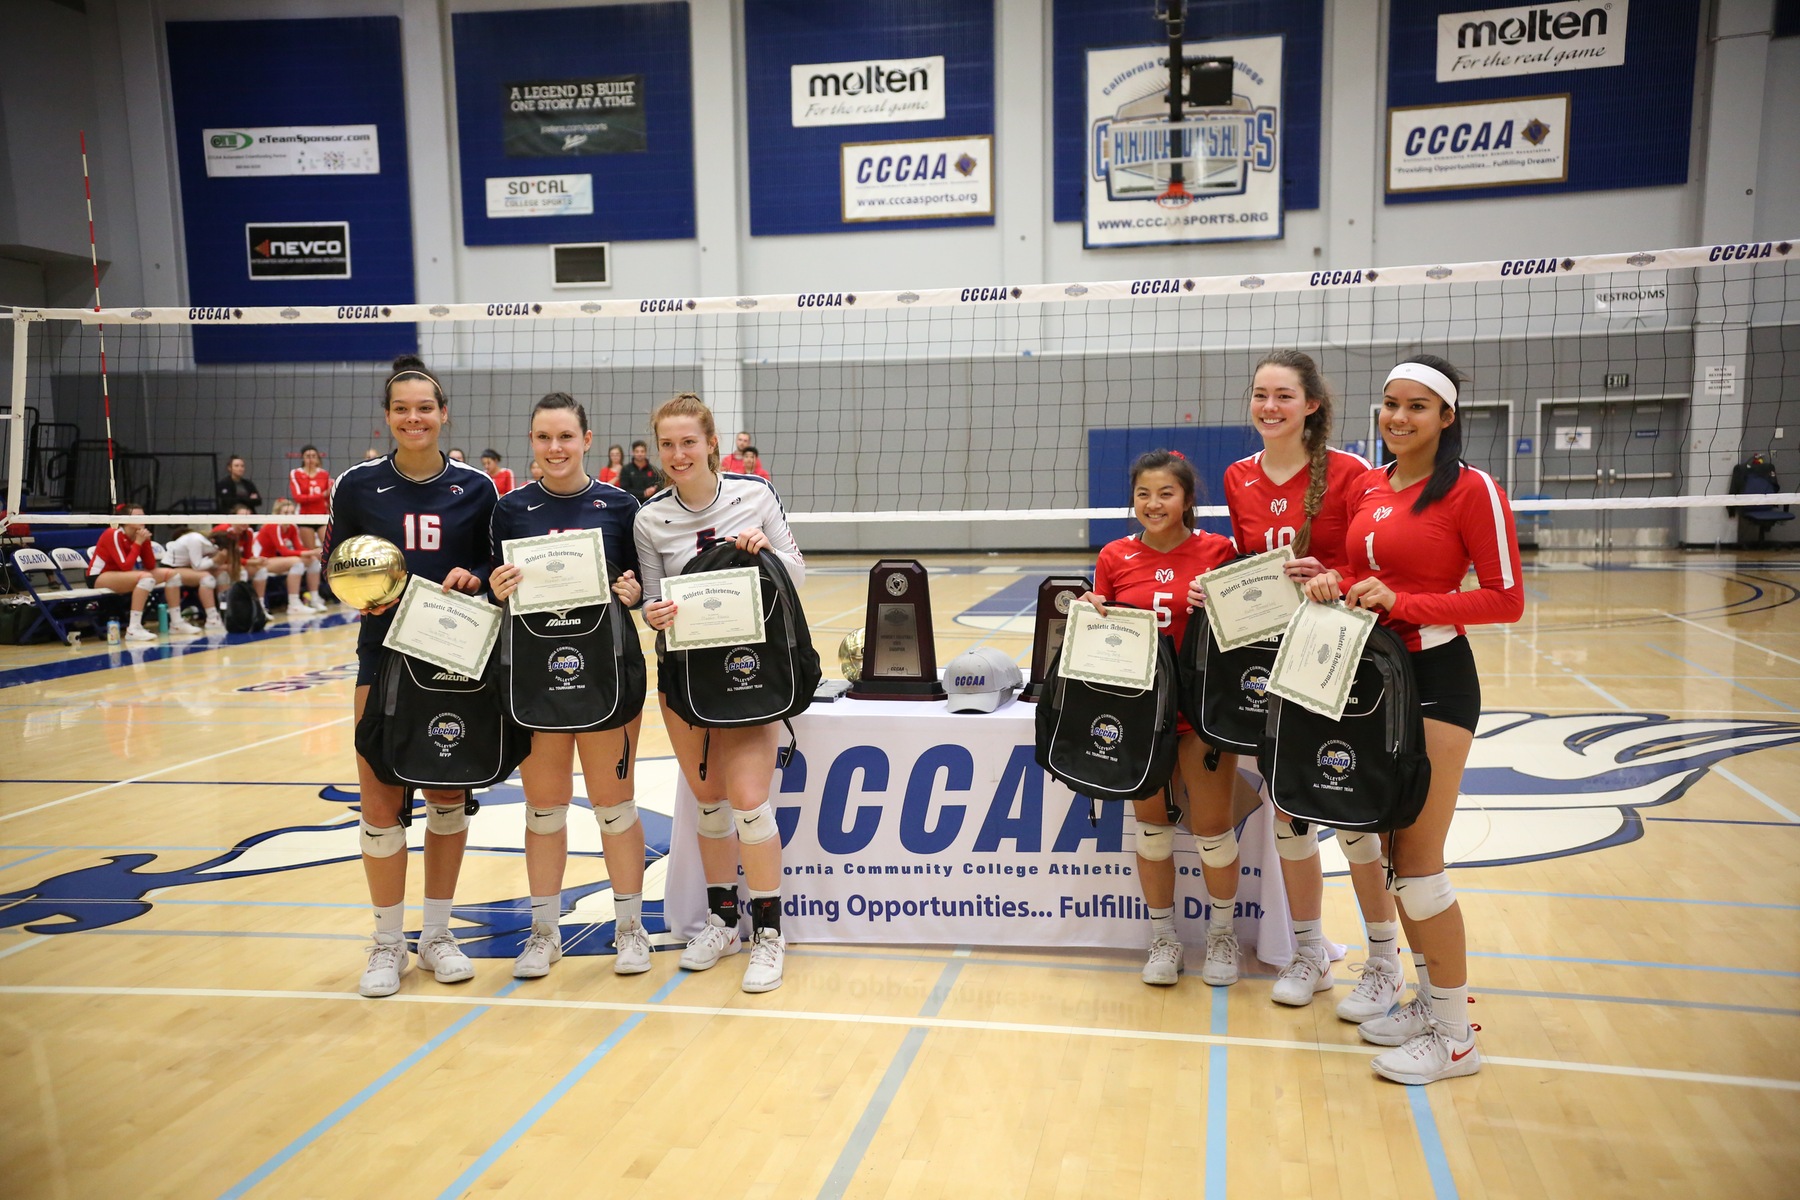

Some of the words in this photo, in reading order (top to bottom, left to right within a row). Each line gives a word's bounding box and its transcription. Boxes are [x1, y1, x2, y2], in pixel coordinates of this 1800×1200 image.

[1458, 8, 1607, 48] molten
[1452, 54, 1480, 72] For
[1483, 52, 1511, 67] the
[1514, 46, 1554, 64] real
[1554, 46, 1606, 66] game
[810, 66, 928, 96] molten
[1103, 61, 1154, 96] California
[1232, 62, 1264, 86] ollege
[510, 87, 520, 100] A
[523, 85, 578, 99] LEGEND
[581, 84, 594, 96] IS
[596, 81, 635, 96] BUILT
[510, 101, 535, 112] ONE
[537, 99, 574, 110] STORY
[576, 98, 591, 108] AT
[592, 98, 602, 107] A
[805, 103, 828, 117] For
[830, 102, 850, 114] the
[856, 98, 886, 114] real
[888, 101, 929, 117] game
[259, 134, 370, 145] eTeamSponsor.com
[1405, 120, 1514, 156] CCCAA
[857, 154, 946, 184] CCCAA
[542, 198, 573, 206] SPORTS
[857, 193, 978, 206] www.cccaasports.org
[270, 241, 341, 256] NEVCO
[1709, 243, 1772, 262] CCCAA
[1500, 258, 1557, 276] CCCAA
[1310, 270, 1362, 286] CCCAA
[961, 288, 1007, 302] CCCAA
[1131, 280, 1180, 295] CCCAA
[640, 299, 683, 313] CCCAA
[797, 294, 842, 307] CCCAA
[189, 308, 231, 320] CCCAA
[338, 306, 379, 319] CCCAA
[487, 303, 530, 316] CCCAA
[1608, 374, 1626, 386] EXIT
[404, 513, 441, 550] 16
[18, 553, 47, 565] SOLANO
[56, 553, 81, 563] SOLANO
[524, 554, 546, 564] Athletic
[1365, 532, 1380, 571] 1
[334, 557, 376, 572] molten
[1220, 584, 1240, 598] Athletic
[1242, 575, 1279, 586] Achievement
[682, 591, 703, 601] Athletic
[423, 602, 447, 611] Athletic
[447, 607, 480, 628] Achievement
[1153, 592, 1173, 628] 5
[1110, 624, 1140, 637] Achievement
[1338, 626, 1346, 651] Athletic
[552, 662, 578, 670] CCCAA
[729, 662, 754, 671] CCCAA
[1321, 653, 1341, 689] Achievement
[955, 676, 985, 686] CCCAA
[432, 727, 459, 735] CCCAA
[1094, 727, 1117, 739] CCCAA
[1321, 756, 1349, 767] CCCAA
[737, 864, 834, 875] Cornia
[842, 863, 952, 877] Community
[963, 862, 1039, 877] College
[1049, 862, 1132, 876] Athletic
[847, 894, 1053, 922] Opportunities...
[1060, 894, 1150, 920] Fulfilli
